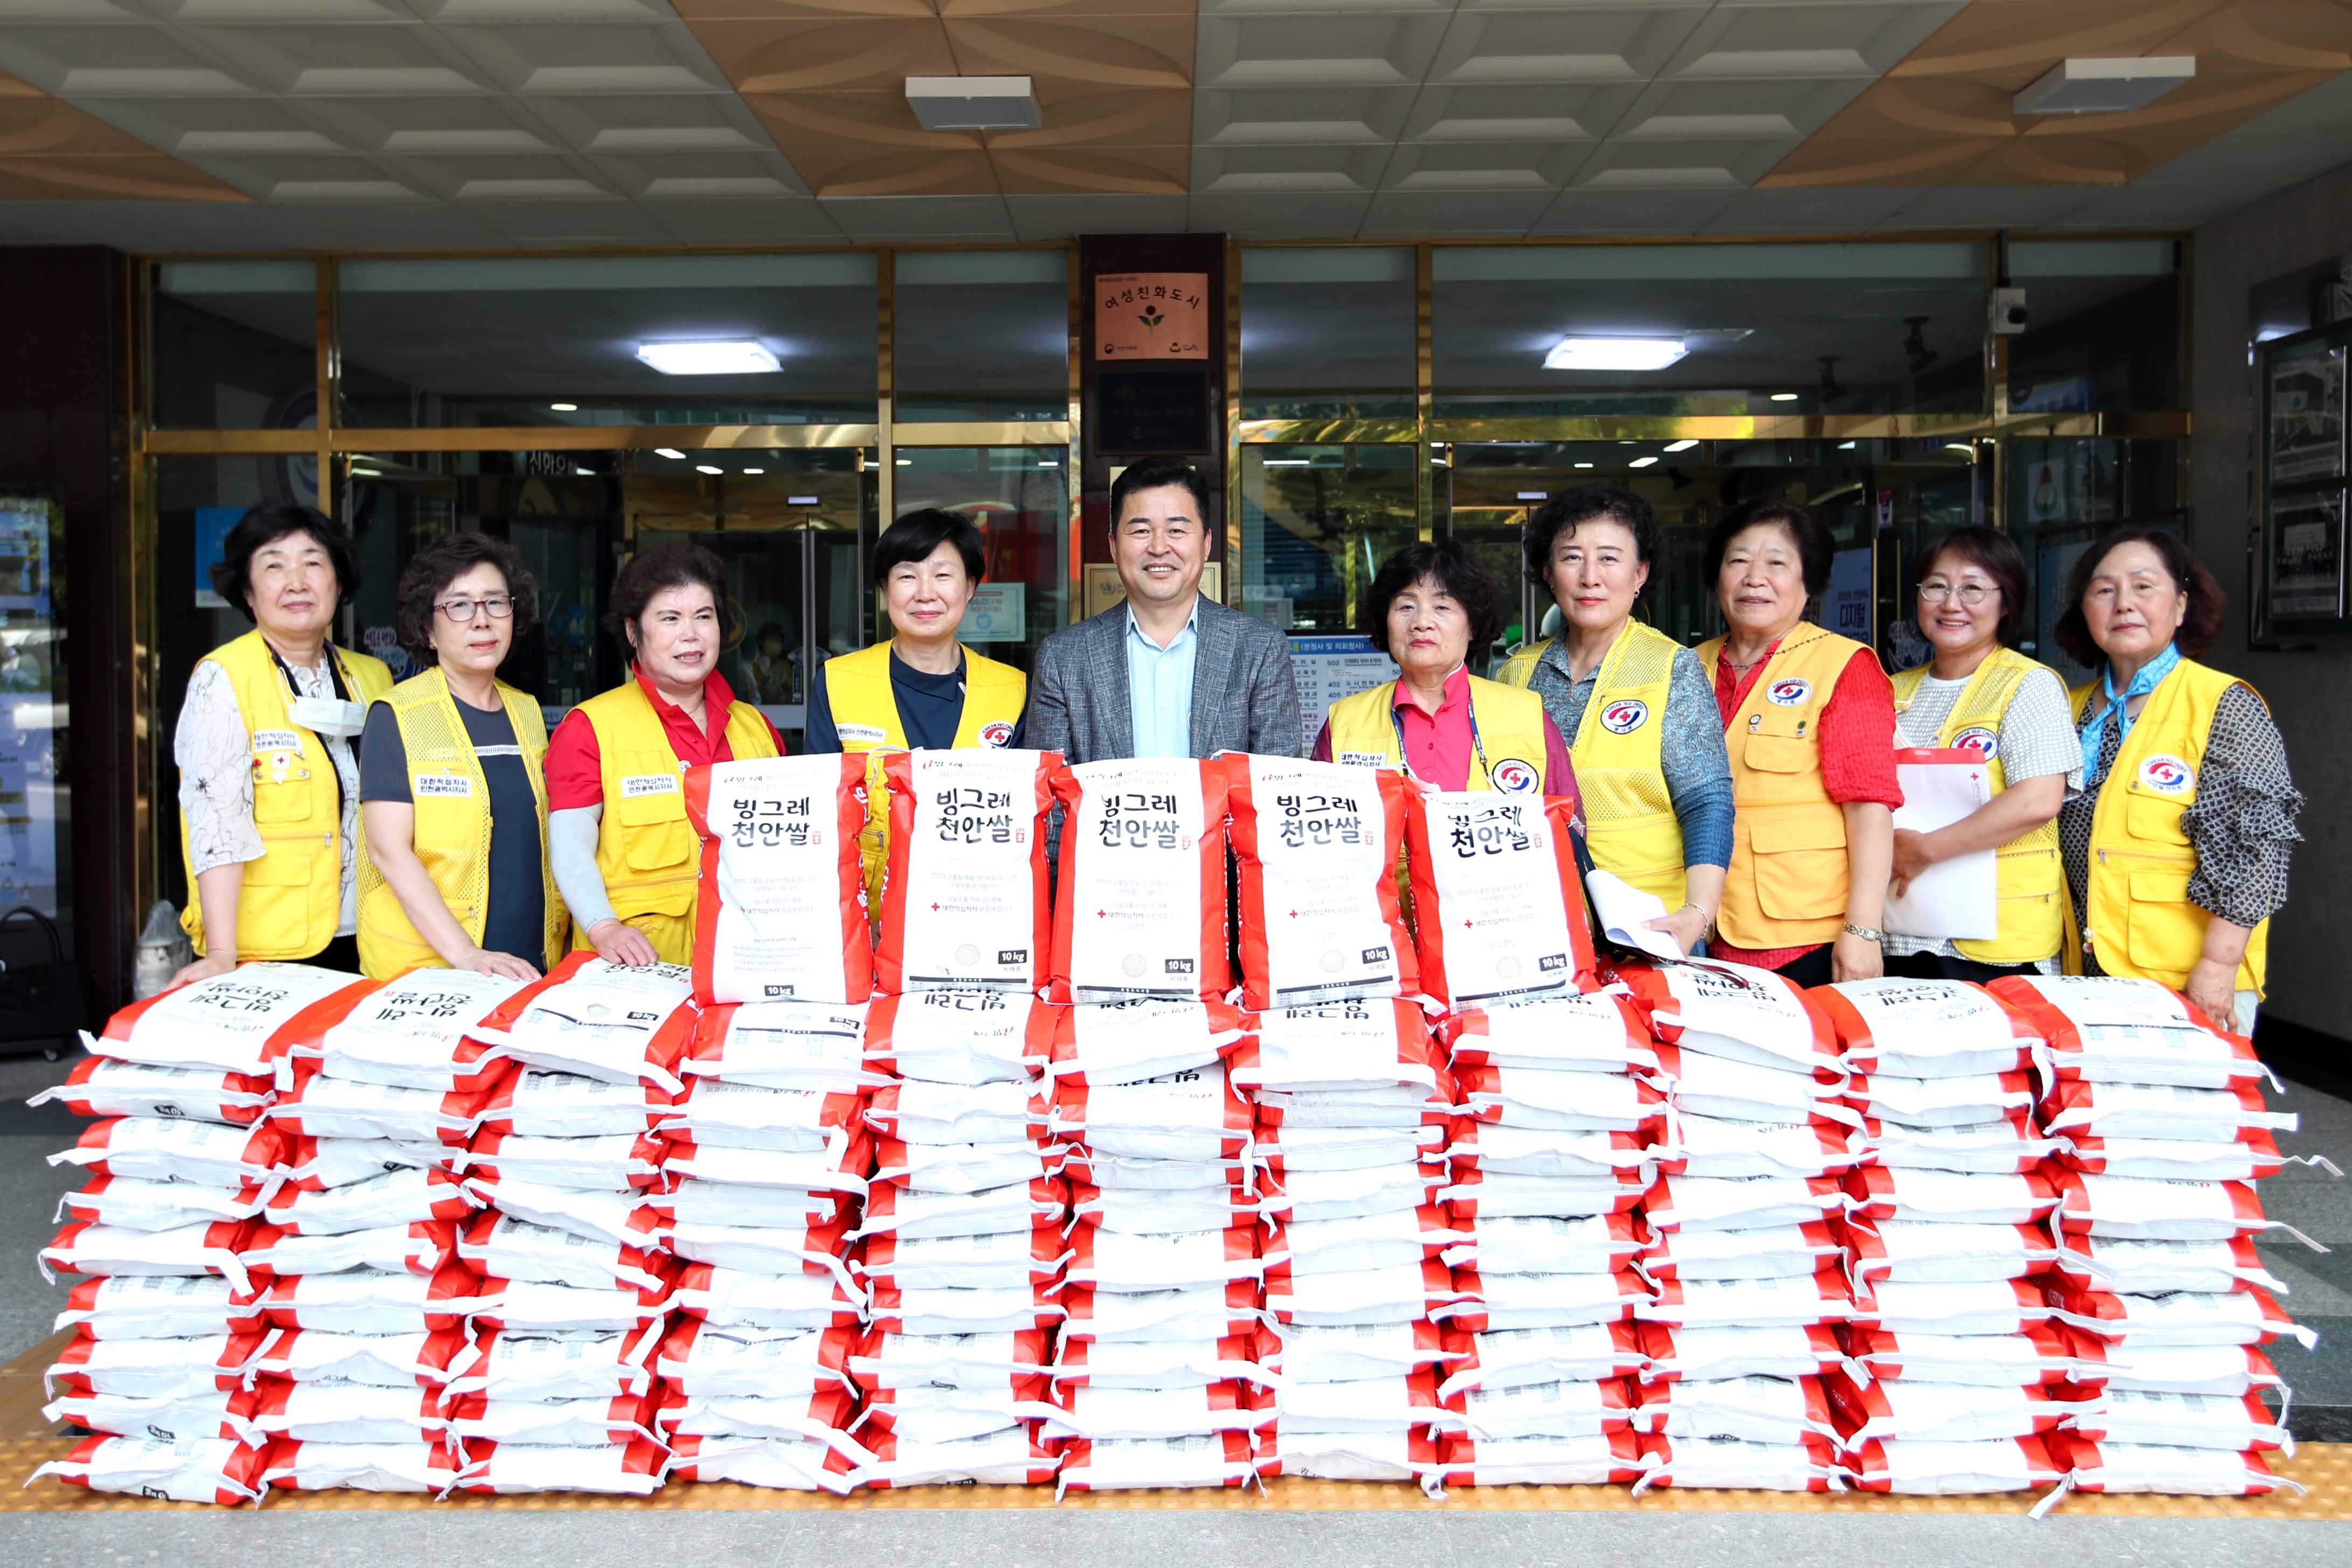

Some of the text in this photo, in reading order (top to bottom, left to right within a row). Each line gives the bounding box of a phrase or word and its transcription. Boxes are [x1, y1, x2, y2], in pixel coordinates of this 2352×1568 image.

[1105, 286, 1199, 310] 여성친화도시
[733, 797, 810, 819] 빙그레
[936, 788, 1010, 816] 빙그레
[1102, 794, 1177, 817] 빙그레
[1277, 795, 1357, 817] 빙그레
[1447, 806, 1522, 827] 빙그레
[732, 822, 810, 848] 천안쌀
[936, 815, 1013, 844] 천안쌀
[1099, 820, 1179, 849] 천안쌀
[1280, 816, 1361, 848] 천안쌀
